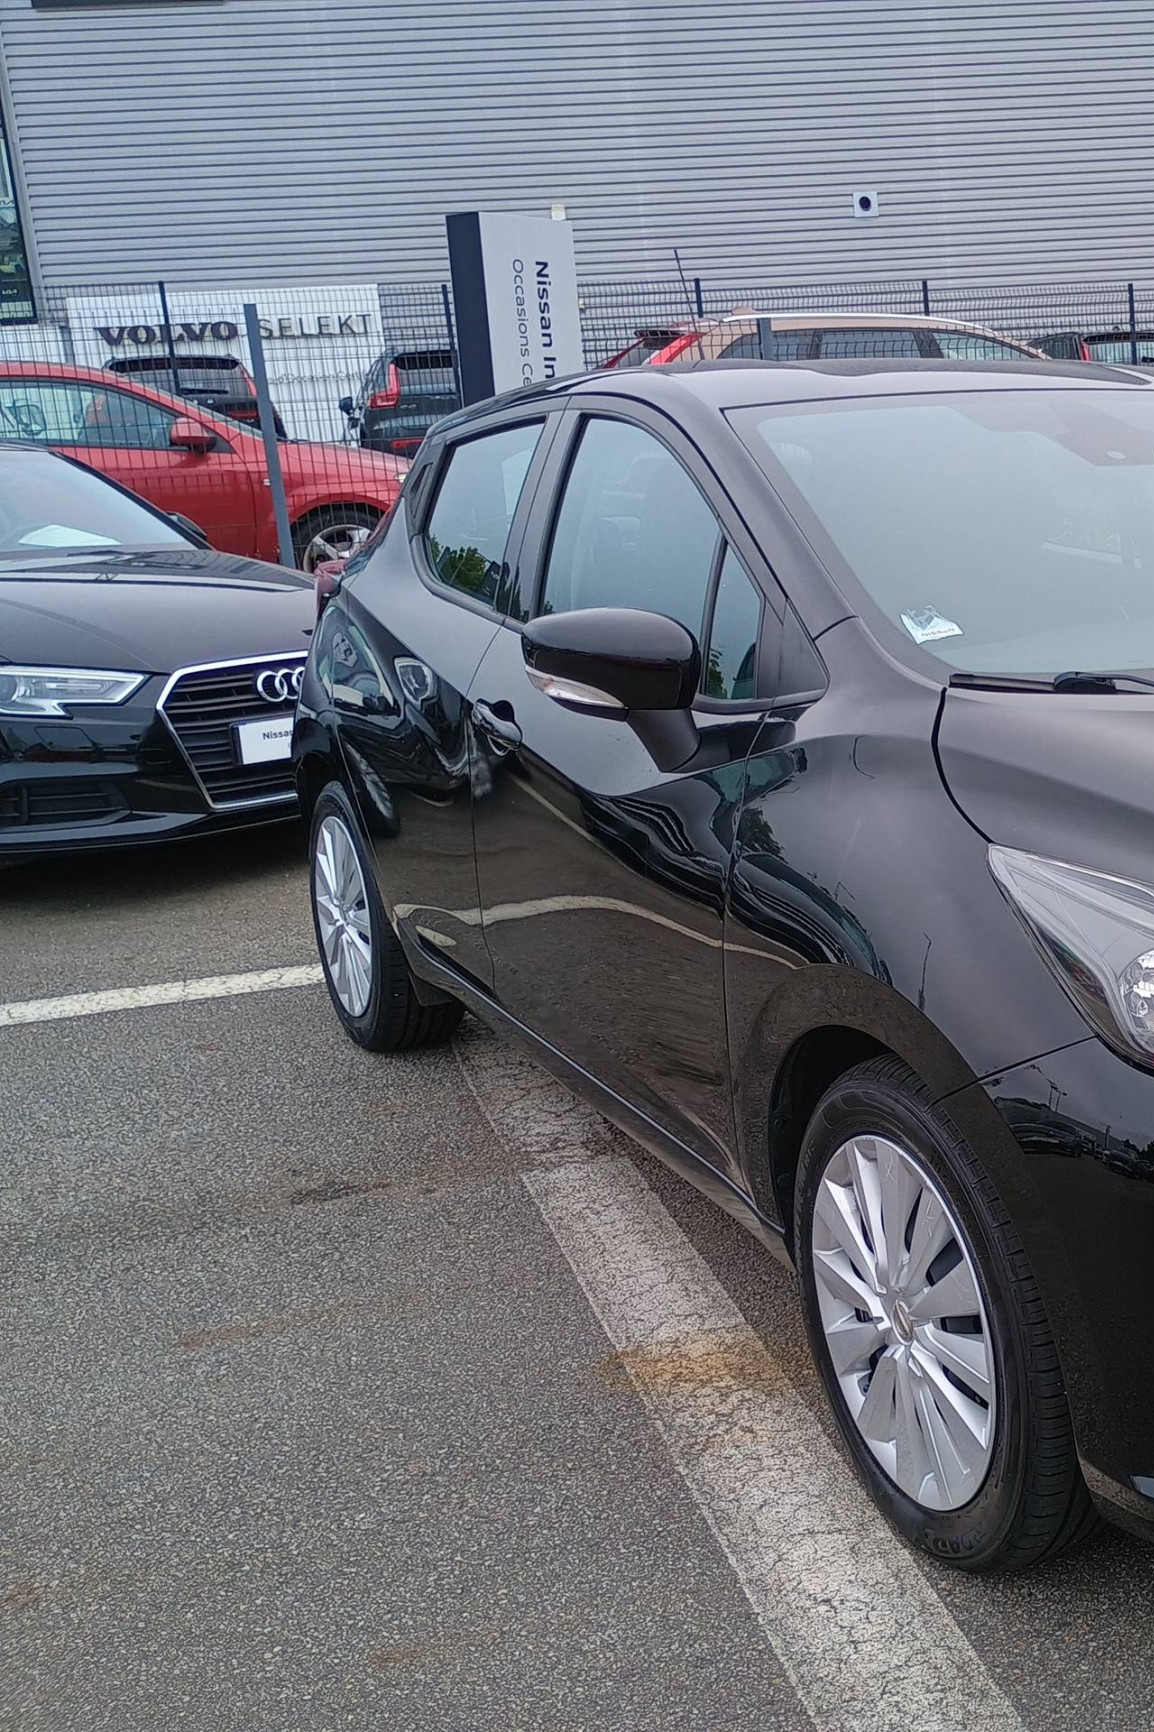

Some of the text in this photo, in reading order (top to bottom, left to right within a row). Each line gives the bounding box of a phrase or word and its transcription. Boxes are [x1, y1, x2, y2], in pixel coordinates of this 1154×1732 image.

[258, 313, 373, 338] SELEKT
[512, 259, 530, 358] Occasions
[535, 261, 553, 347] Nissan
